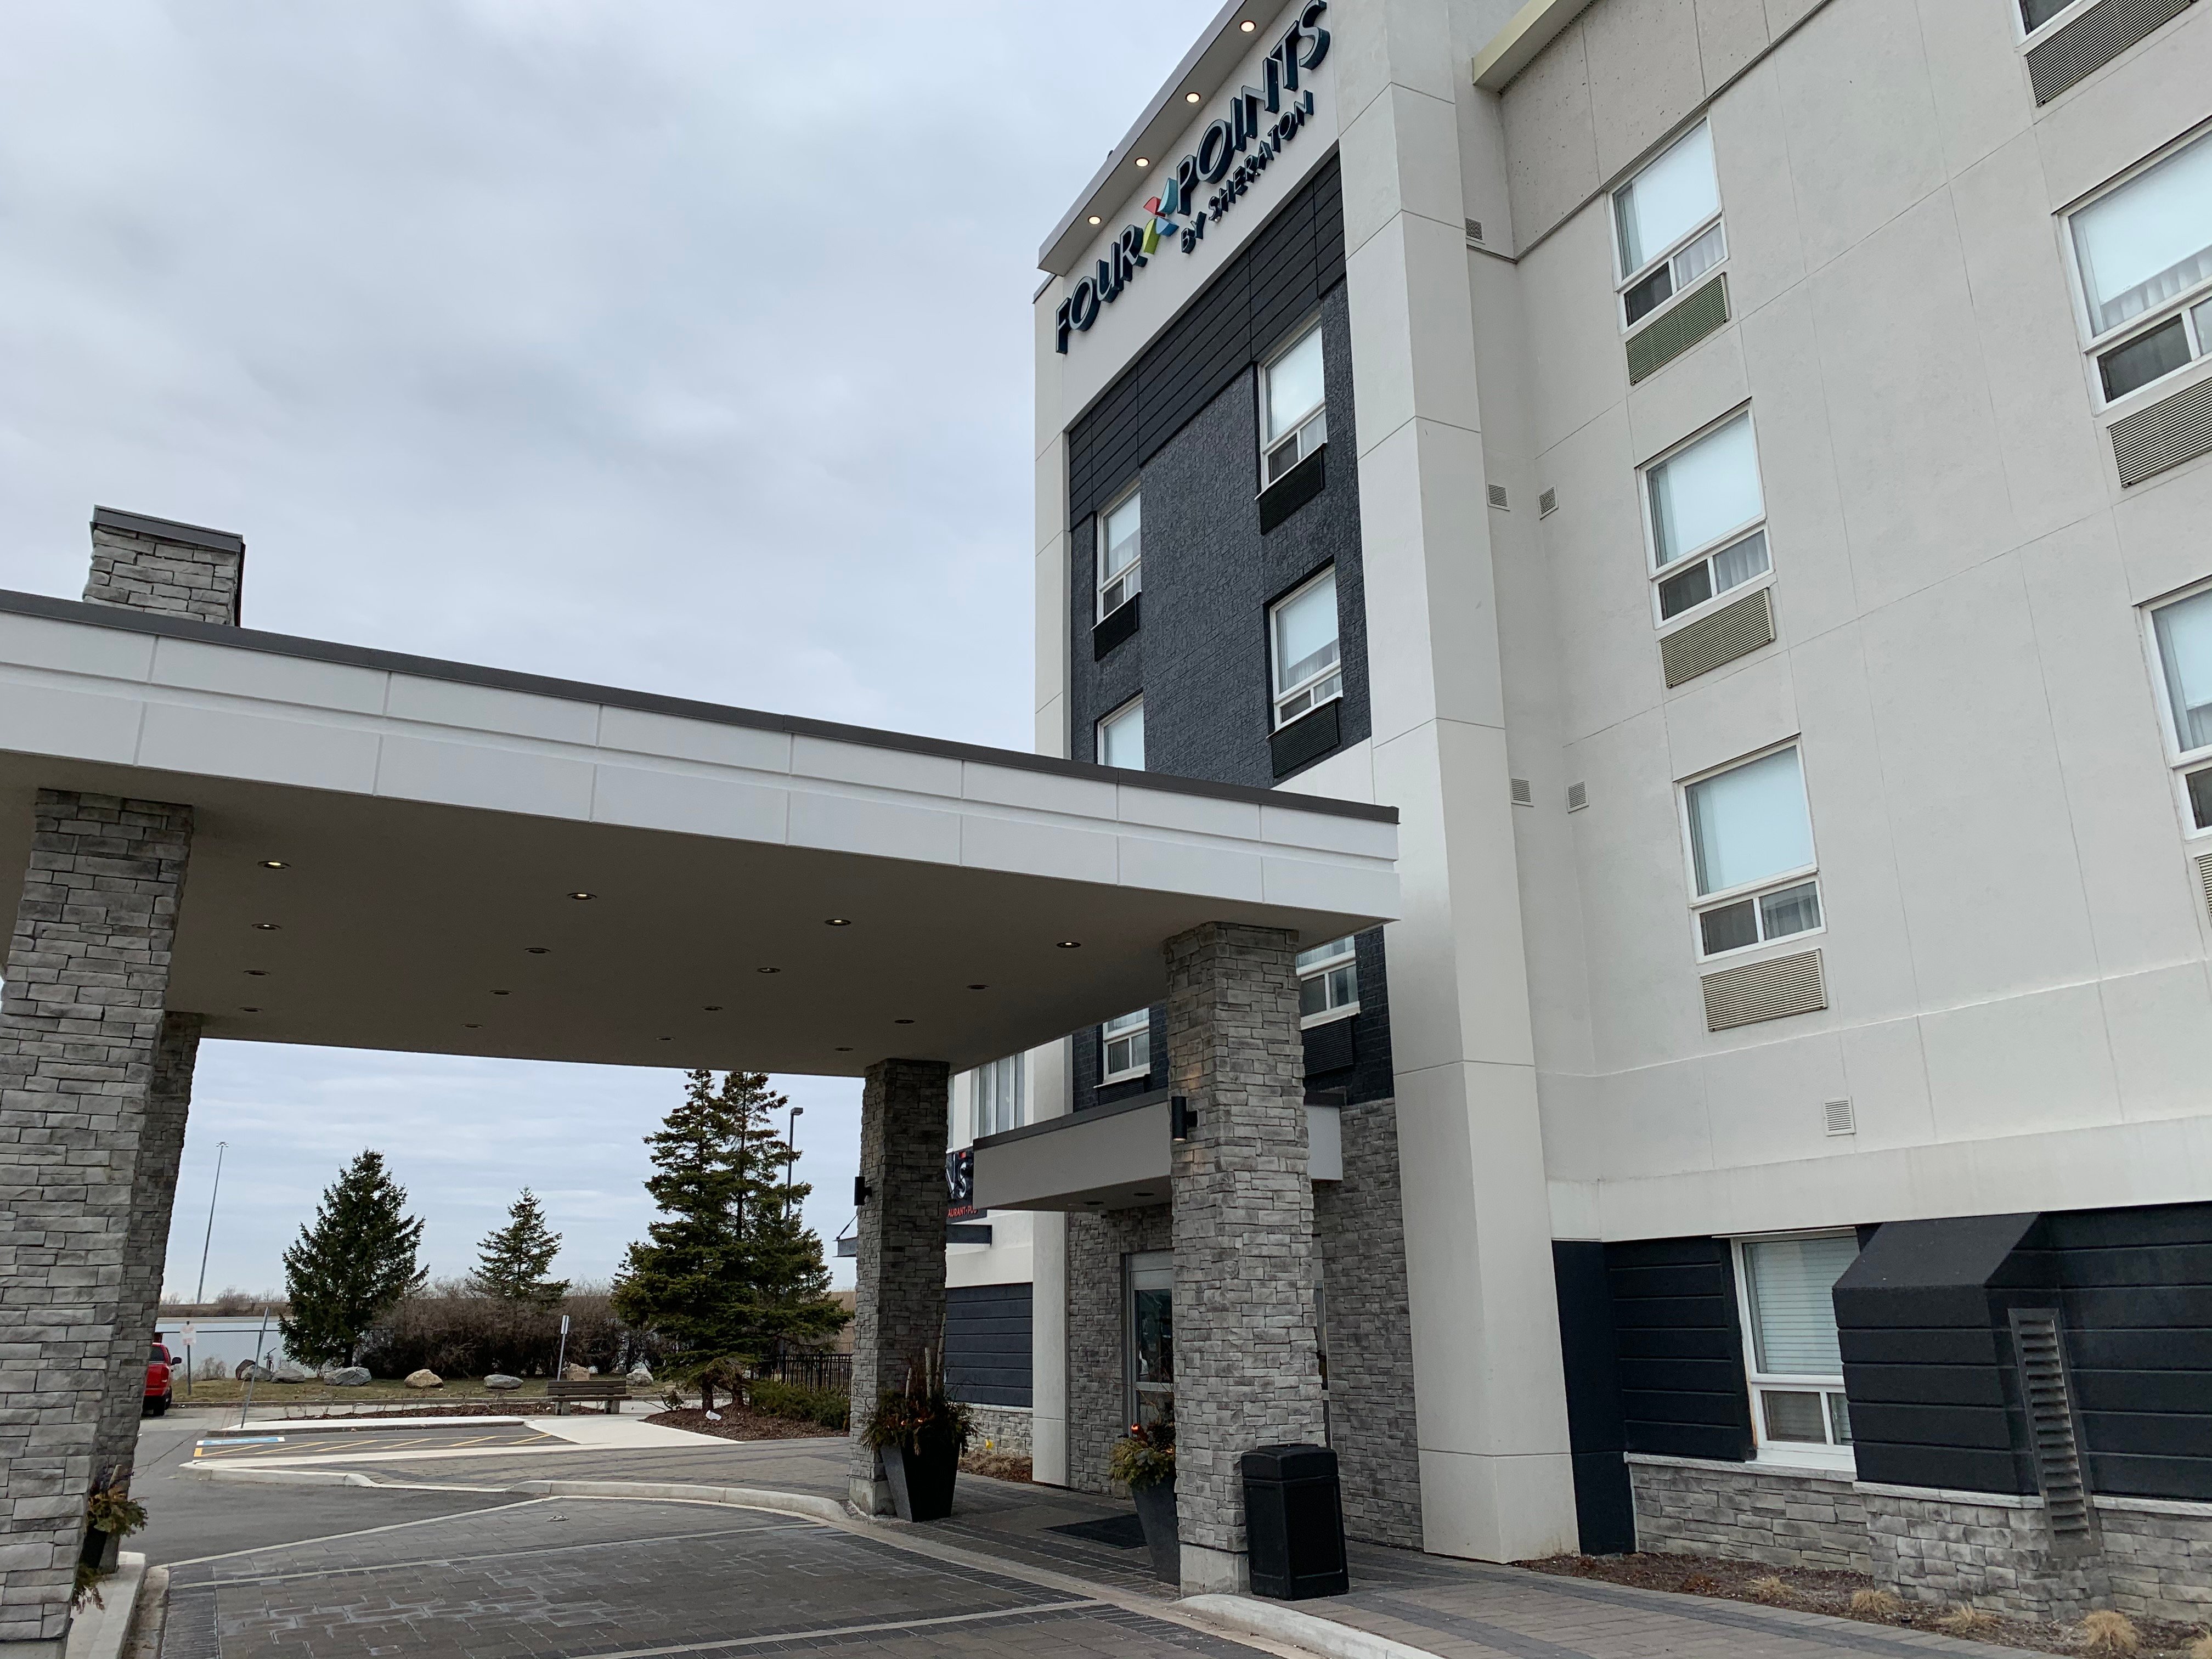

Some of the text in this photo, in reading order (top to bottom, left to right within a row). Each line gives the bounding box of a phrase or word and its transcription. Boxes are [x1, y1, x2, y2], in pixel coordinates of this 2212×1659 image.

[1056, 0, 1330, 354] FOUR POINTS
[1181, 89, 1314, 254] BY SHERATON
